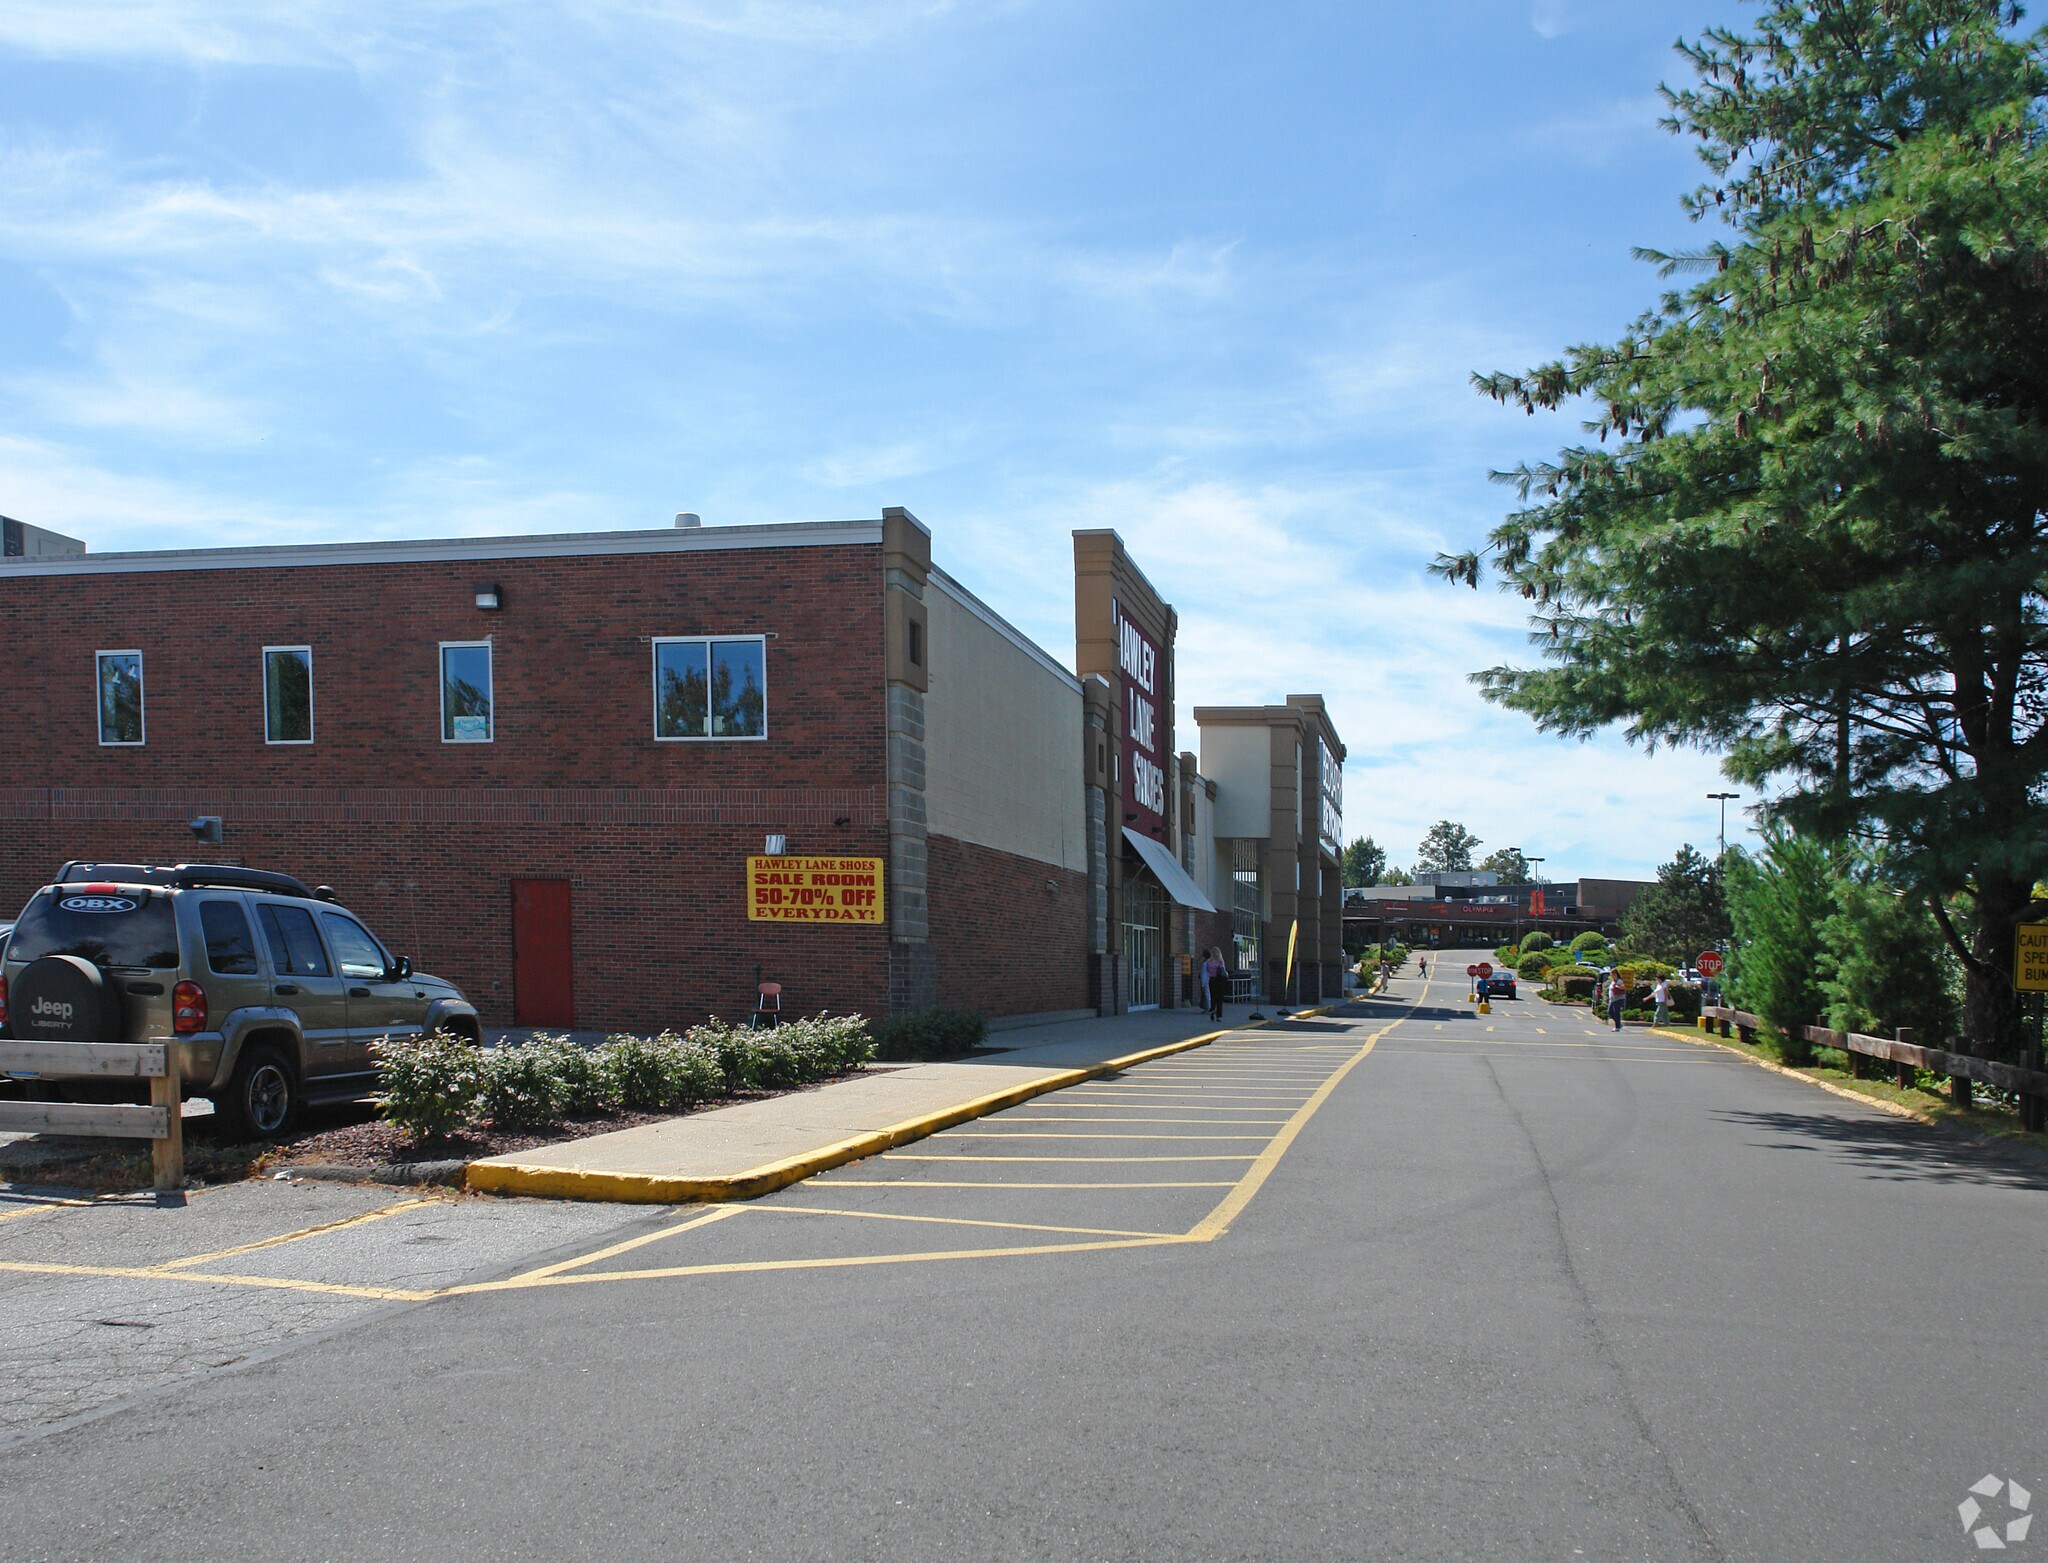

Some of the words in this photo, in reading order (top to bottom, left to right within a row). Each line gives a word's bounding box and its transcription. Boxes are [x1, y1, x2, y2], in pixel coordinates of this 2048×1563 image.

[1129, 687, 1155, 753] LANE
[1133, 751, 1164, 816] SHOES
[755, 859, 802, 870] HAWLEY
[805, 860, 837, 870] LANE
[839, 860, 875, 871] SHOES
[755, 873, 804, 885] SALE
[812, 874, 875, 886] ROOM
[755, 888, 834, 905] 50-70%
[841, 889, 876, 906] OFF
[67, 899, 126, 909] OBX
[1462, 905, 1494, 913] OLYMPIA
[755, 907, 875, 920] EVERYDAY!
[2024, 951, 2048, 964] SPE
[1477, 967, 1492, 975] STOP
[1697, 960, 1721, 970] STOP
[31, 996, 73, 1019] Jeep
[31, 1020, 73, 1029] LIBERTY
